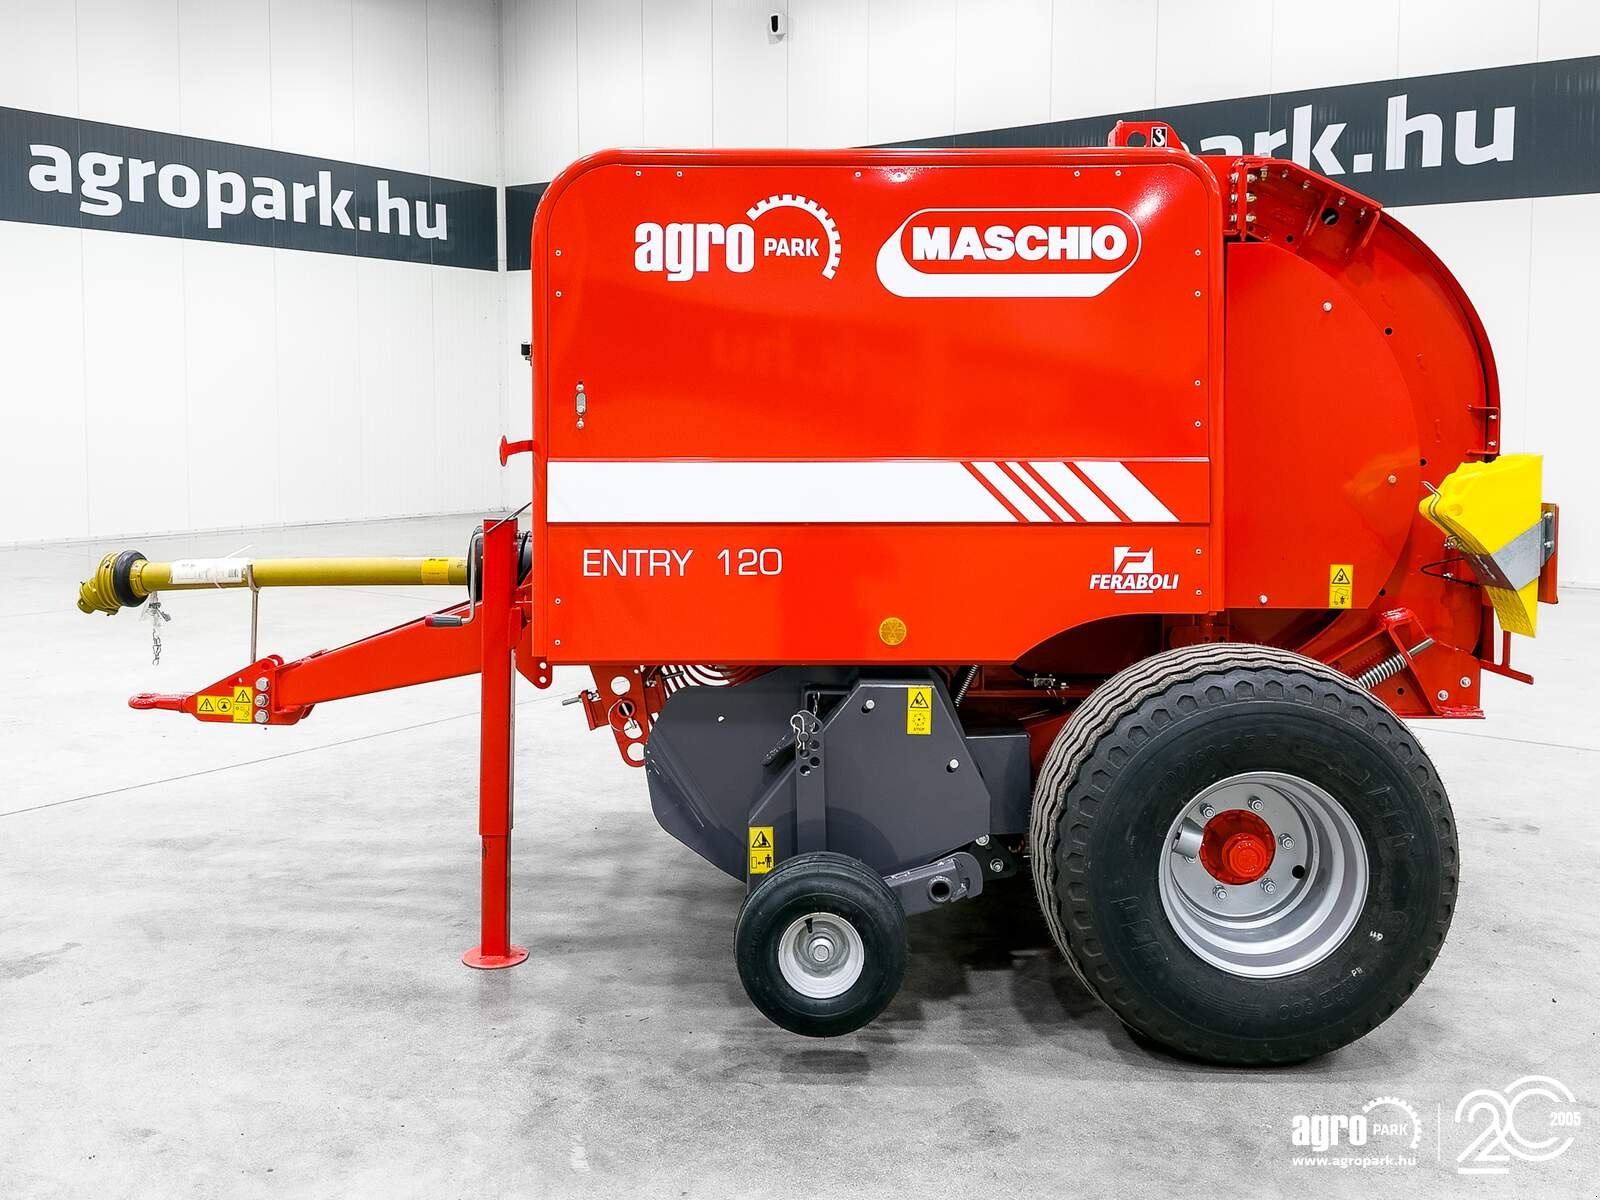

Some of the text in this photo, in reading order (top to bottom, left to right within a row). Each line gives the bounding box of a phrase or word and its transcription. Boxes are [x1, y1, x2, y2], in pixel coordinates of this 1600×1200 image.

[28, 143, 448, 242] agropark.hu
[634, 222, 820, 282] agro PARK
[911, 225, 1128, 262] MASCHIO
[583, 548, 783, 577] ENTRY 120
[1089, 573, 1180, 590] FERABOLI
